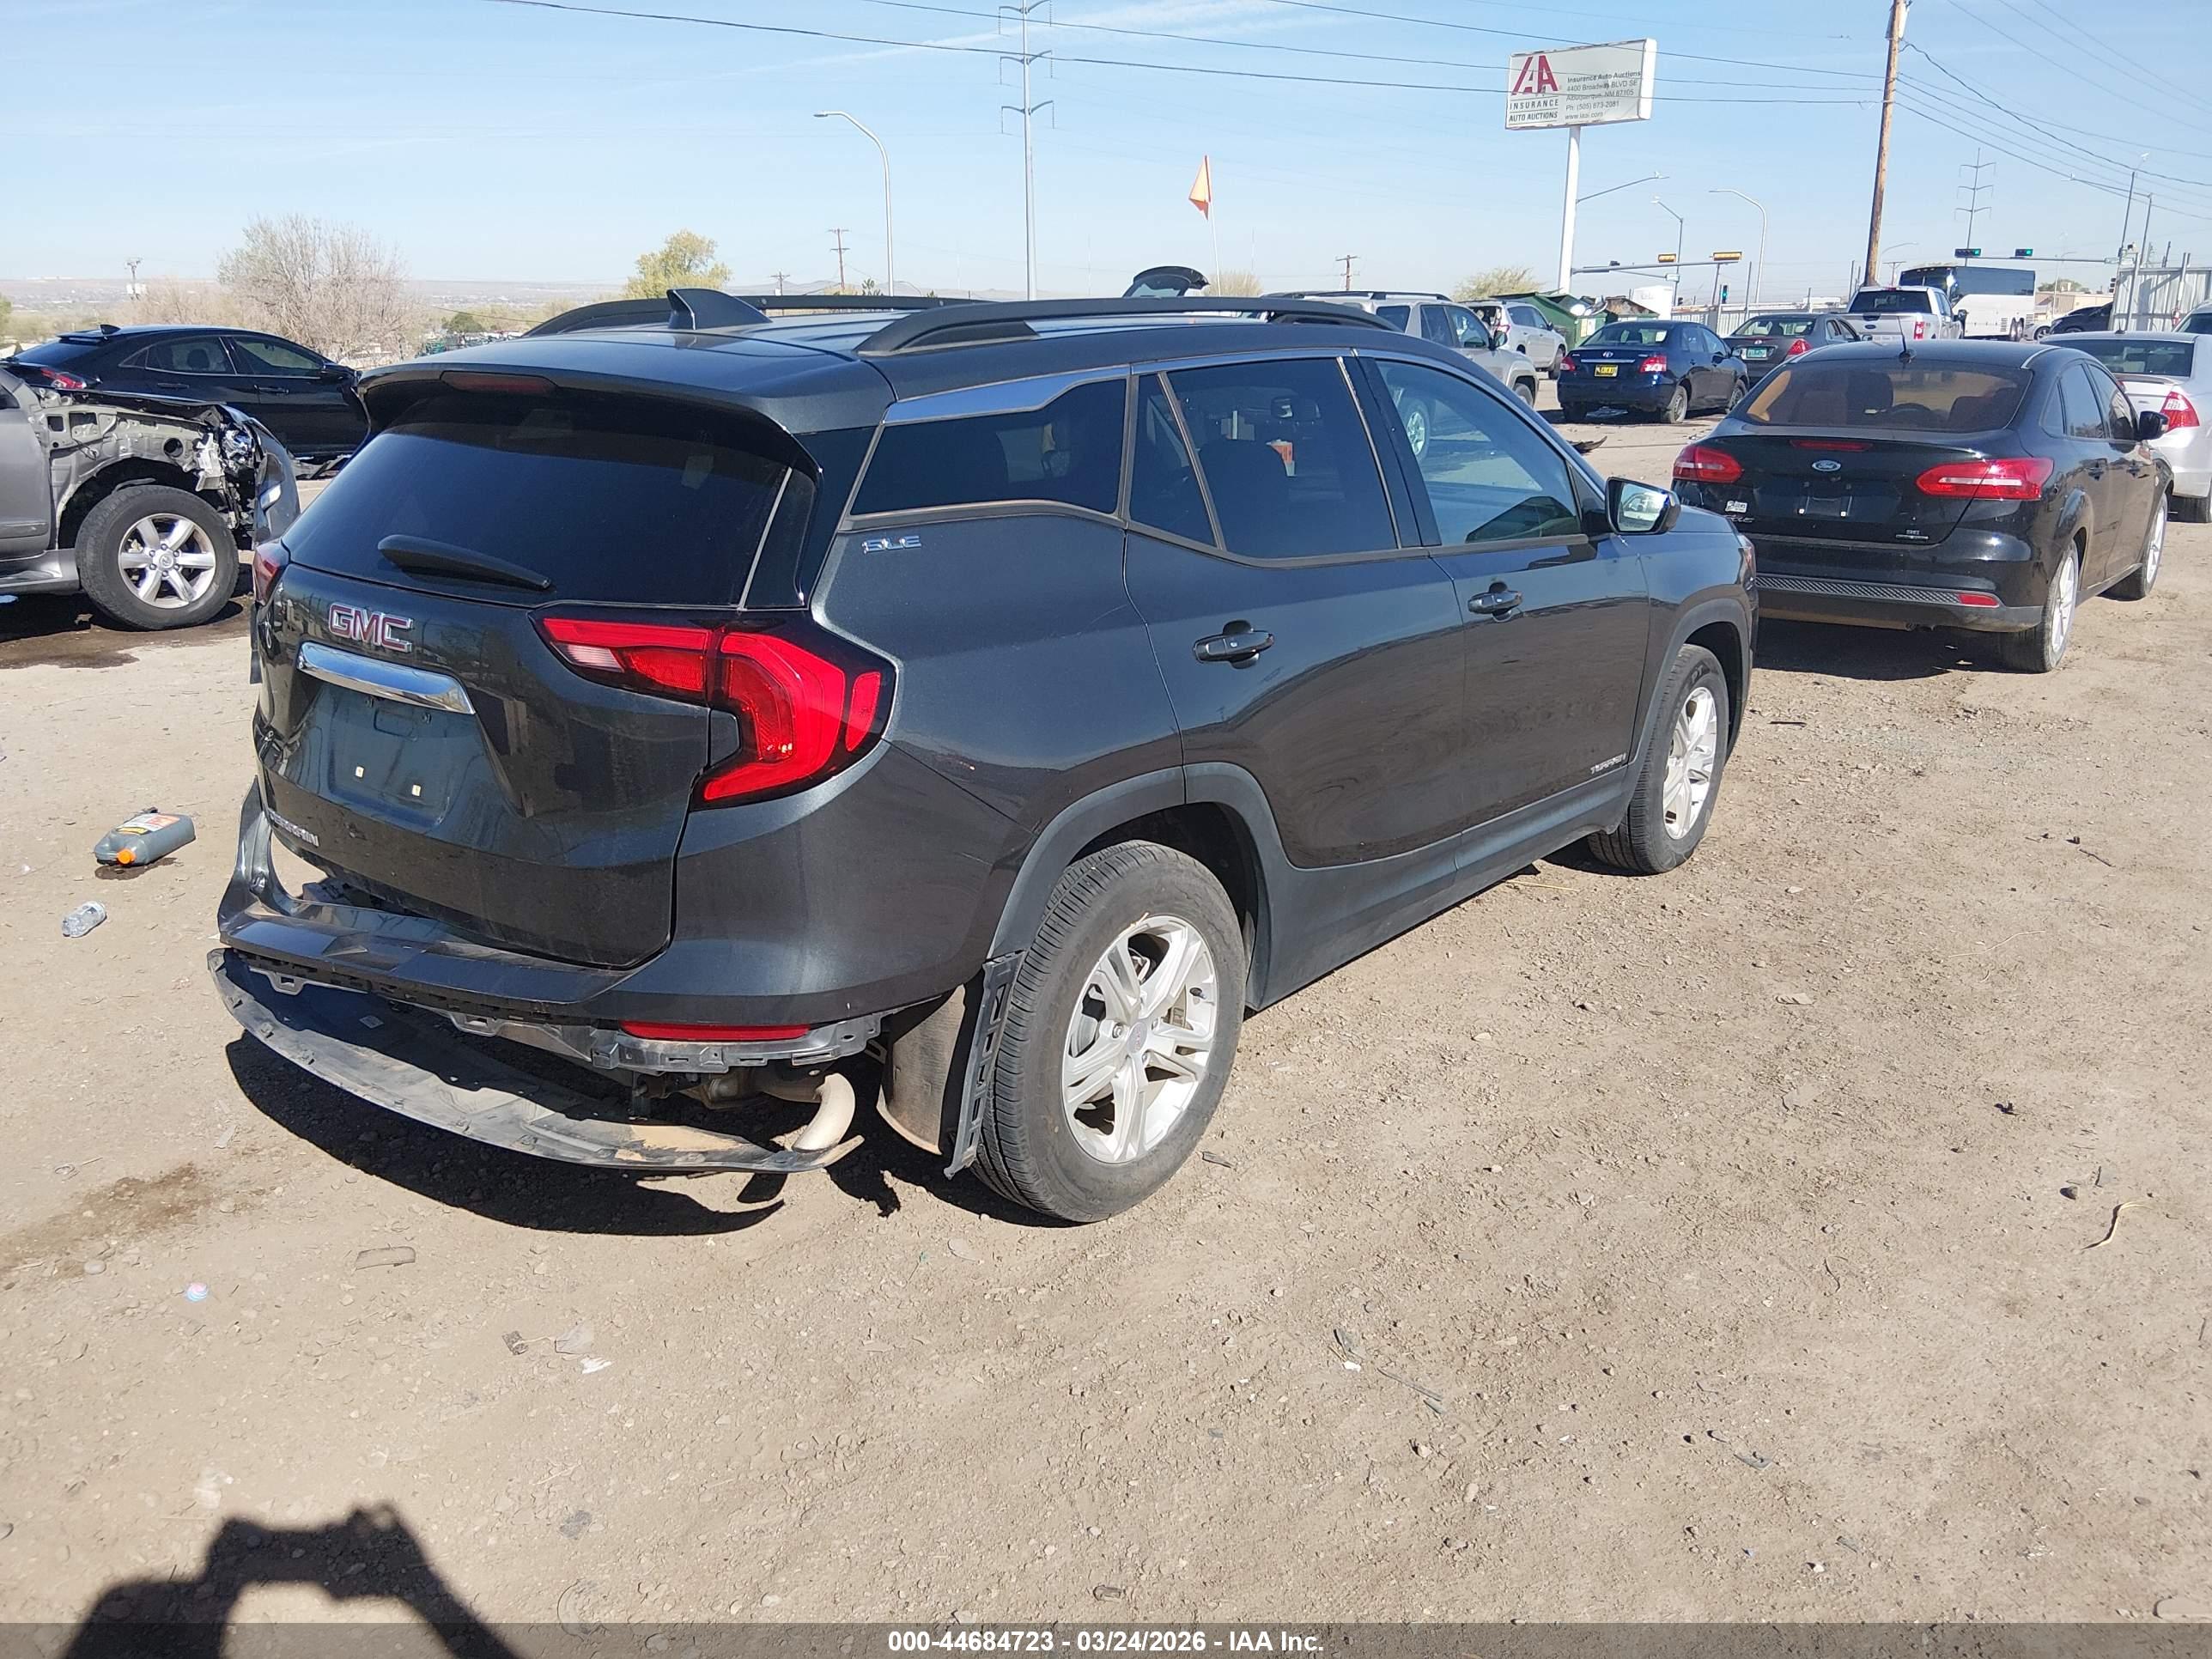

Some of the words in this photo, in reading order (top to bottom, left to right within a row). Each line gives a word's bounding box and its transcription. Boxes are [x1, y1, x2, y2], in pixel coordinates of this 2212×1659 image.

[1567, 75, 1597, 83] Insurance
[1613, 70, 1642, 79] Auctions
[1510, 99, 1559, 111] INSURANCE
[1509, 113, 1526, 123] AUTO
[1527, 112, 1558, 121] AUCTIONS
[861, 536, 921, 555] SLE
[328, 603, 413, 653] GMC
